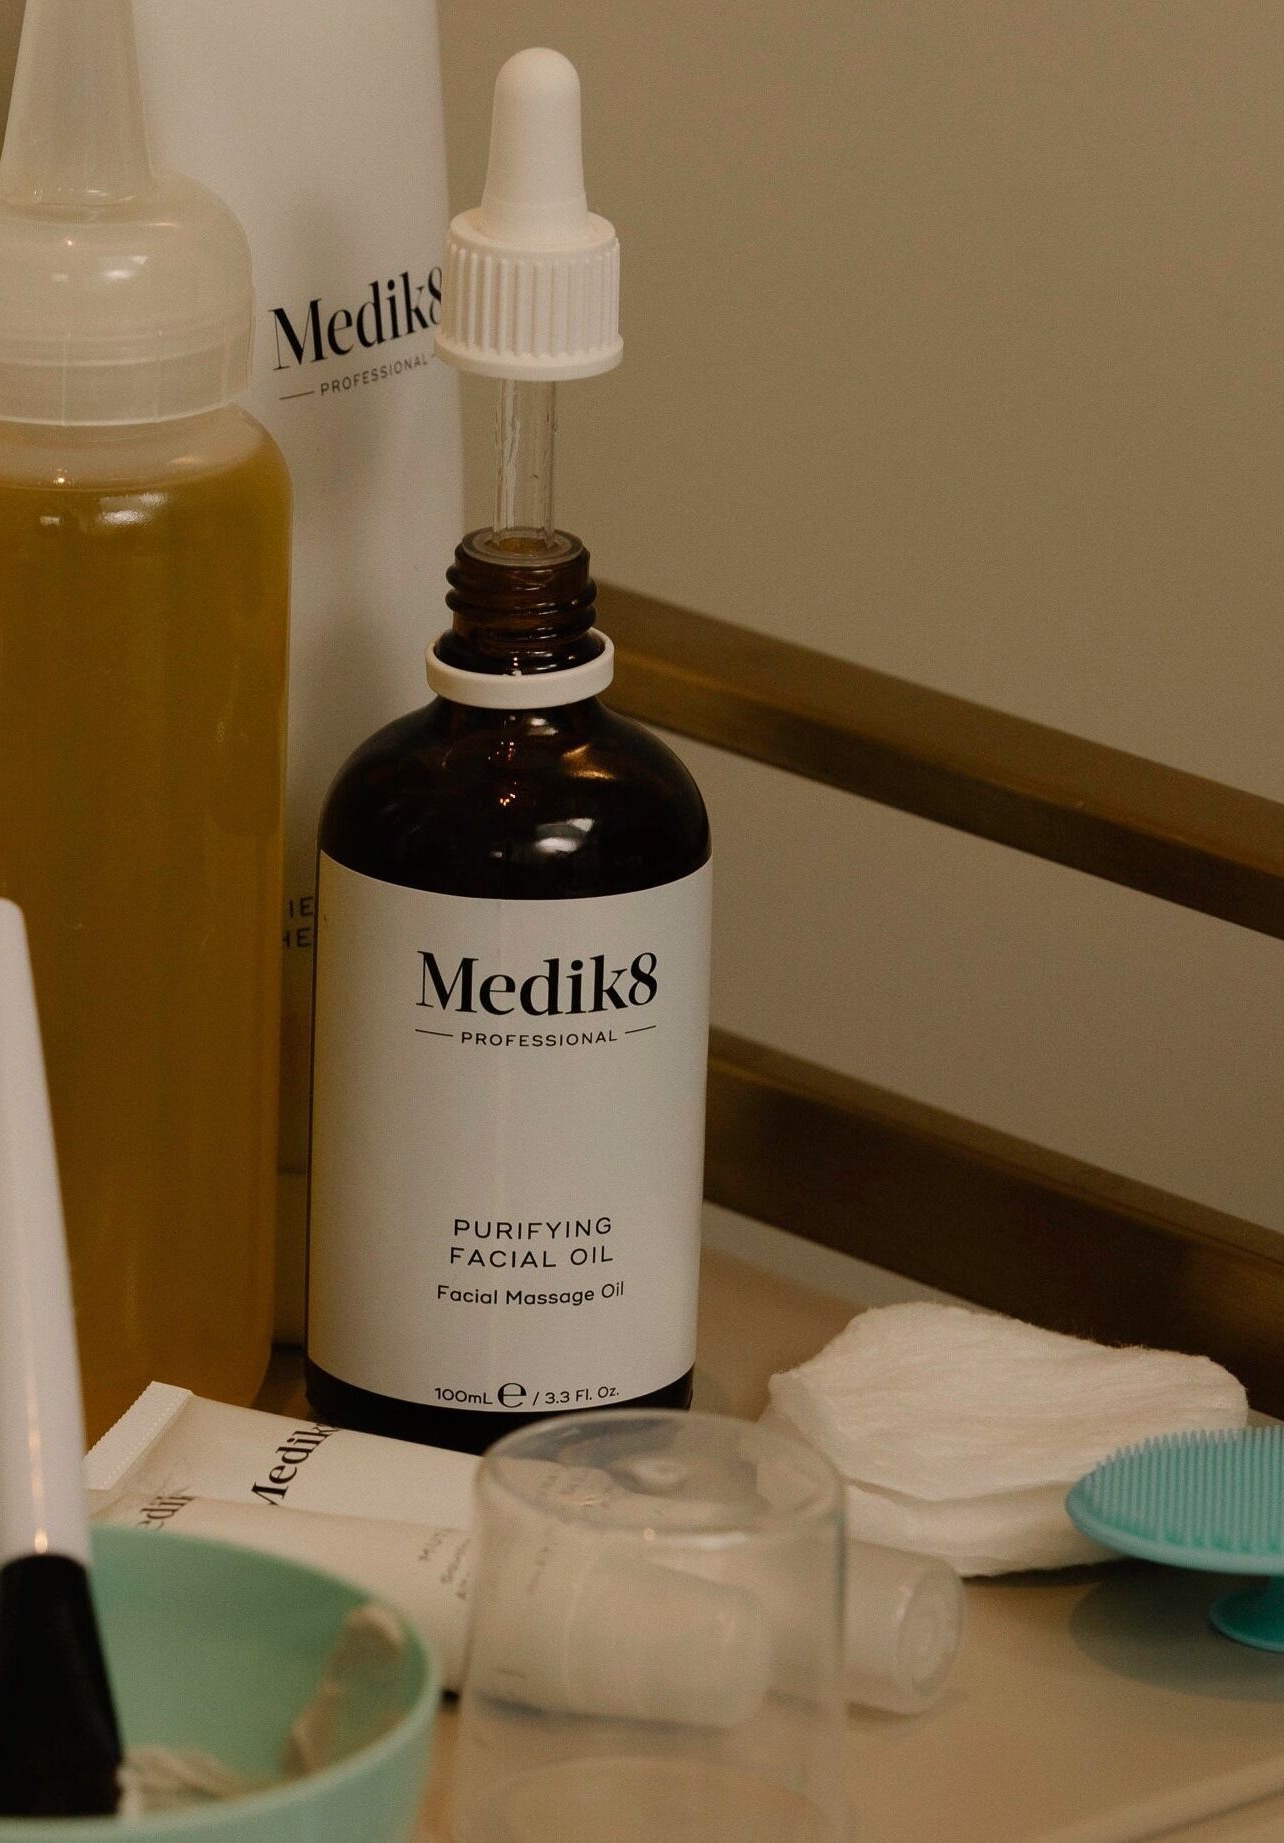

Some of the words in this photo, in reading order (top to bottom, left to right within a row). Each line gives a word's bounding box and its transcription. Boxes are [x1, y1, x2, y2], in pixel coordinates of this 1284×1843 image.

[268, 266, 443, 371] Medik8
[320, 353, 428, 396] PROFESSIONAL
[416, 950, 658, 1017] Medik8
[461, 1030, 618, 1047] PROFESSIONAL
[454, 1217, 612, 1240] PURIFYING
[450, 1247, 557, 1269] FACIAL
[570, 1246, 613, 1266] OIL
[437, 1284, 498, 1305] Facial
[505, 1289, 595, 1307] Massage
[601, 1281, 624, 1299] Oil
[434, 1387, 493, 1406] 100mL
[532, 1391, 540, 1406] /
[545, 1391, 570, 1404] 3.3
[575, 1388, 592, 1403] Fl.
[597, 1386, 619, 1399] Oz.
